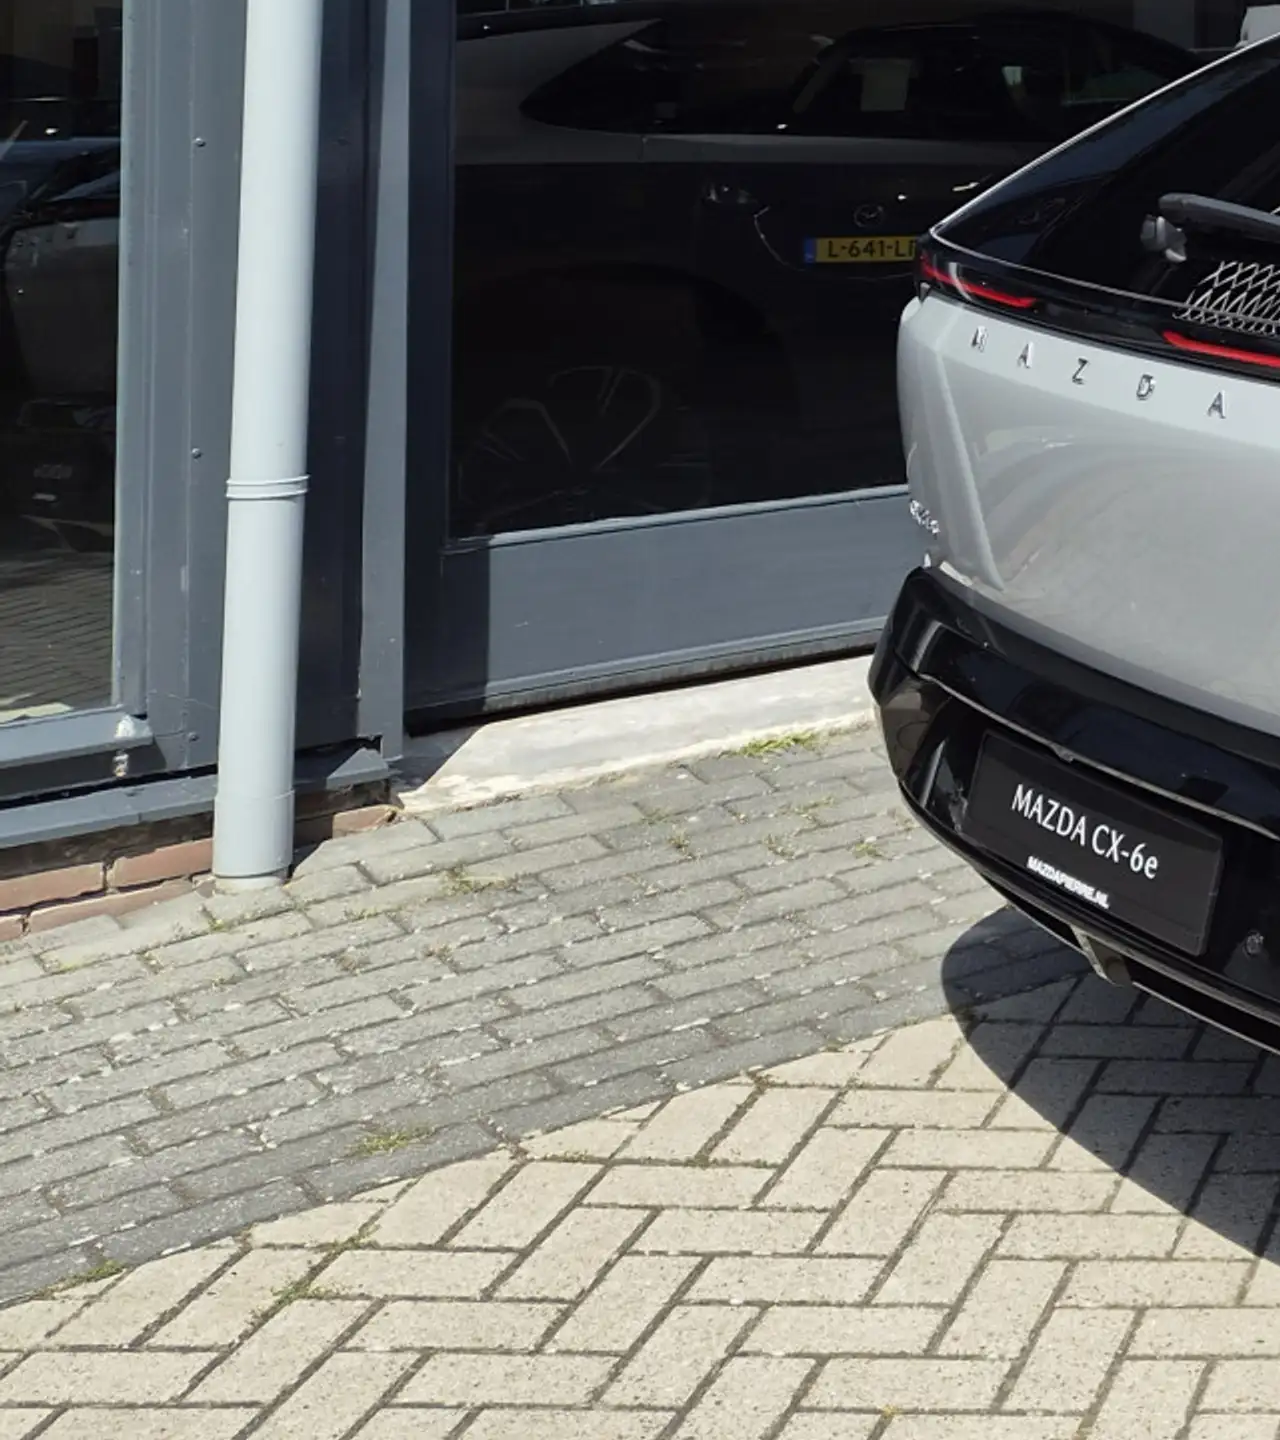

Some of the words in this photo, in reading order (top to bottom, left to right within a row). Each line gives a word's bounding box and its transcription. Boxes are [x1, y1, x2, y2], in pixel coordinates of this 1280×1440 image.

[970, 325, 1227, 420] MAZDA
[1011, 783, 1087, 847] MAZDA
[1091, 823, 1159, 880] CX-6e
